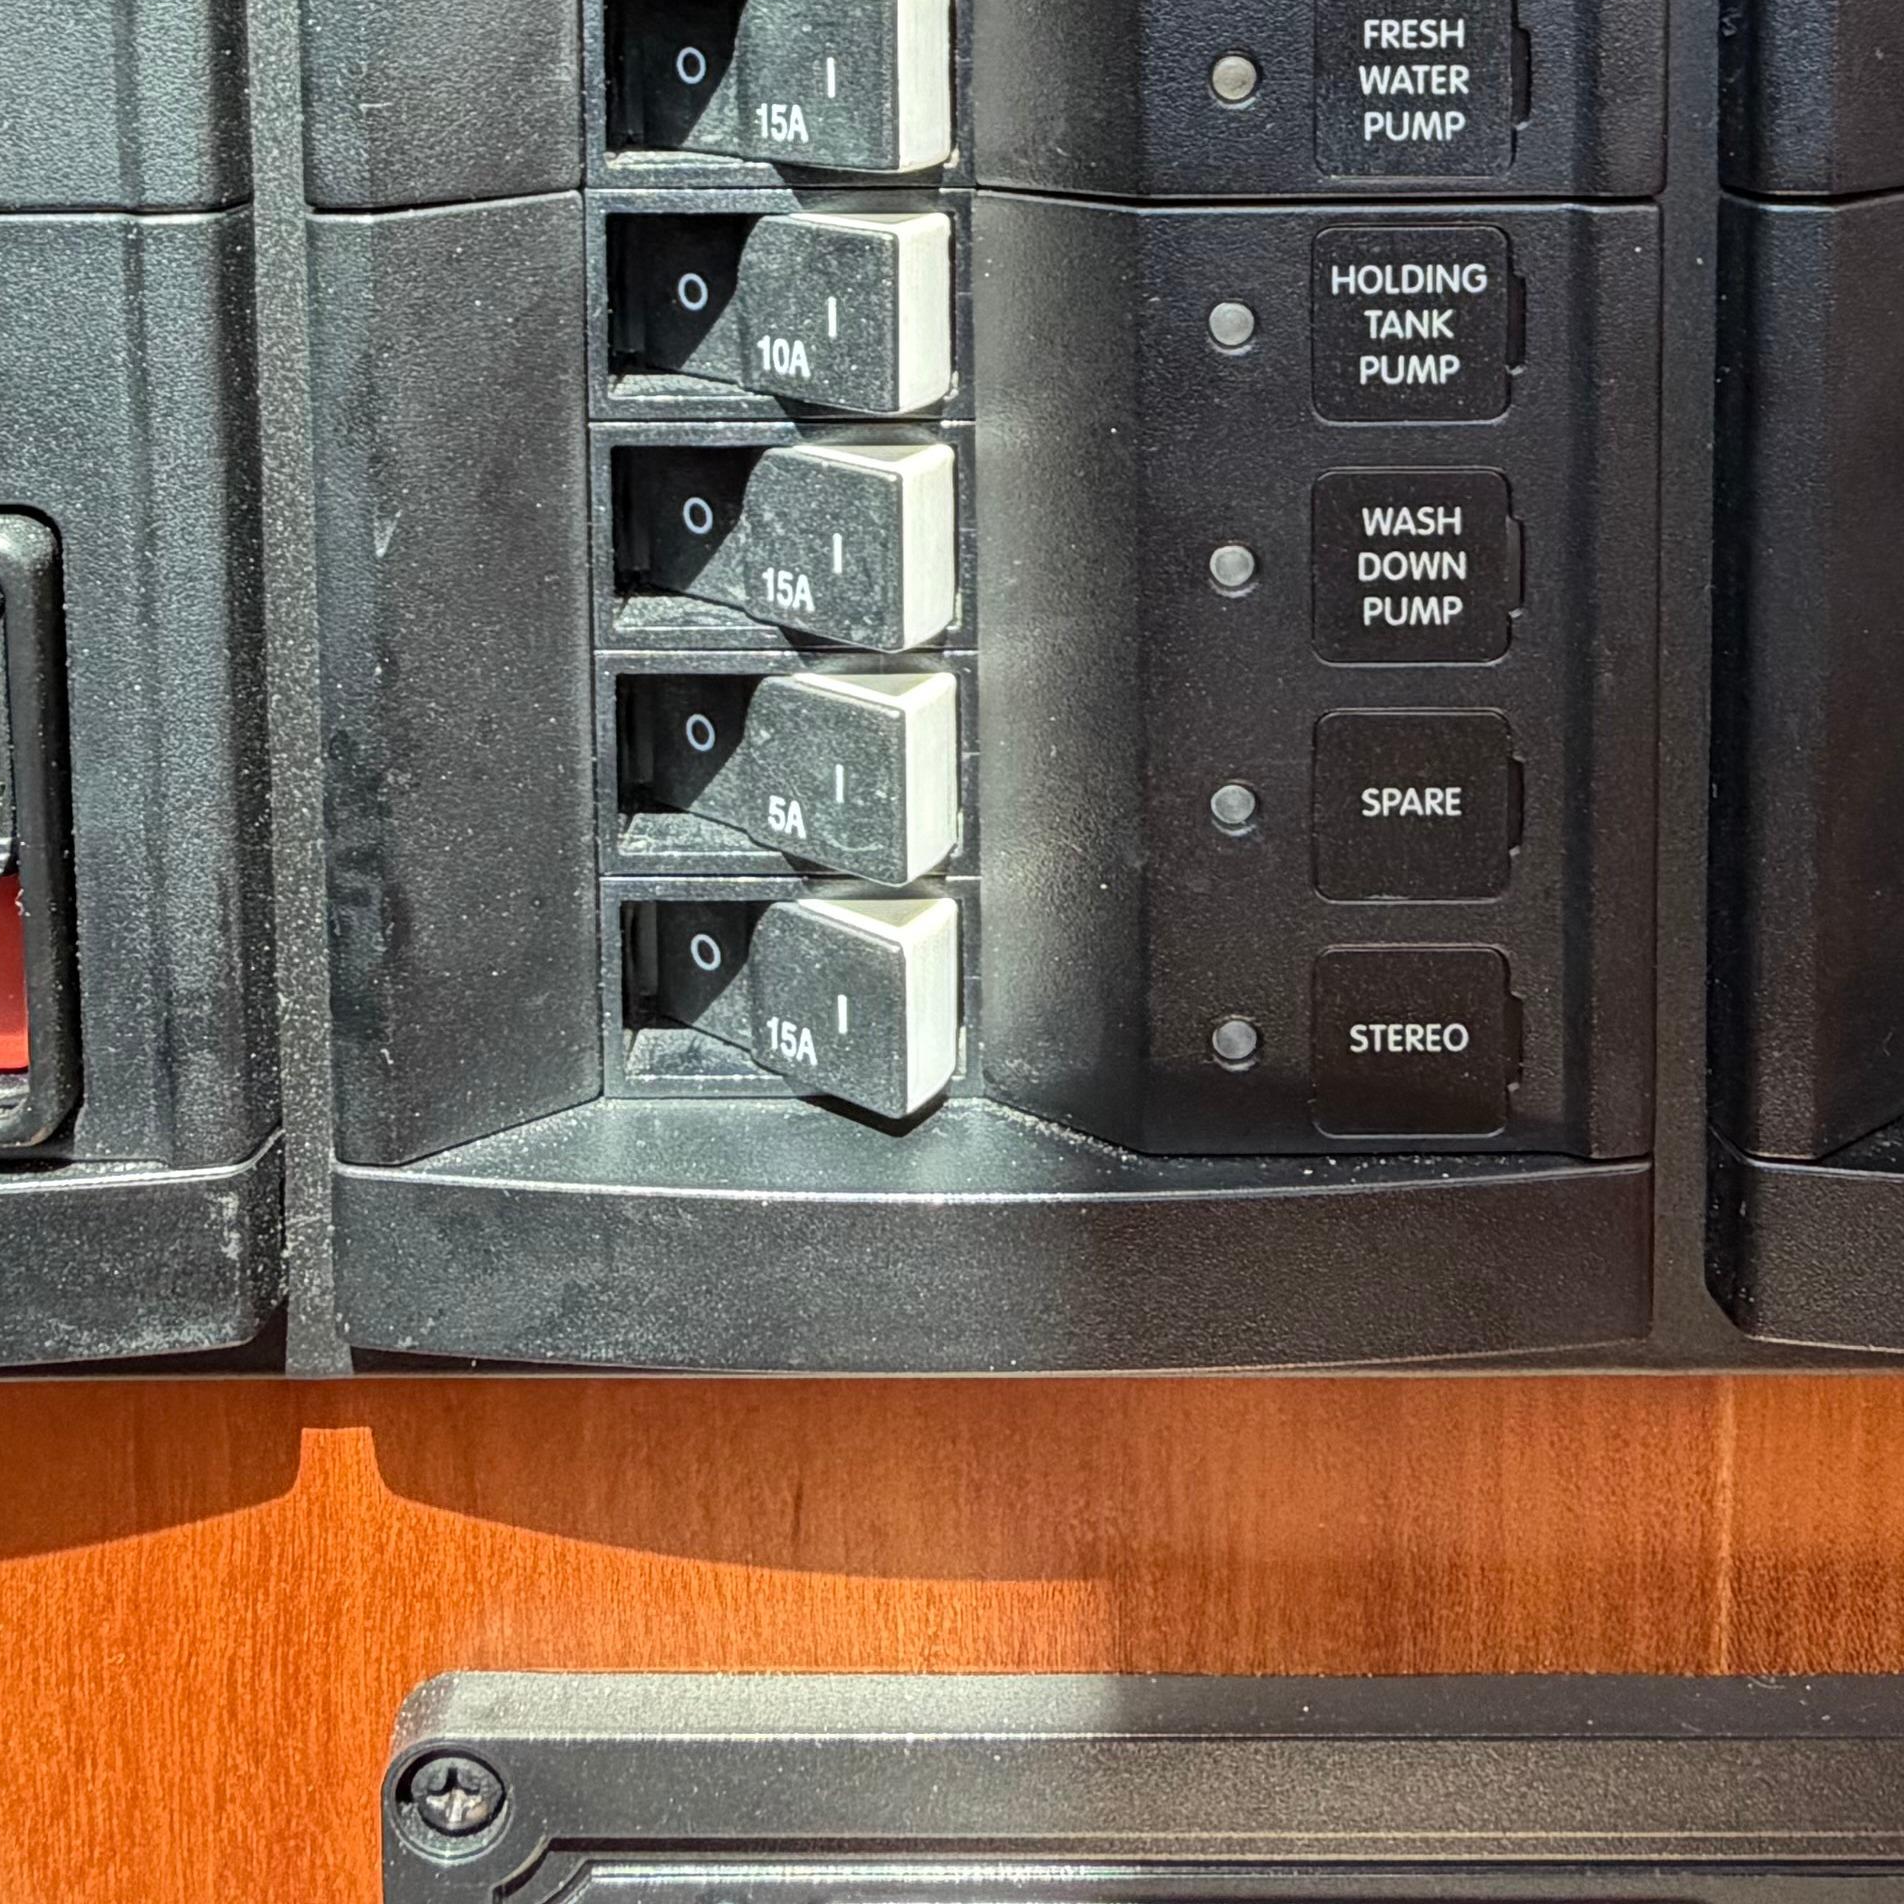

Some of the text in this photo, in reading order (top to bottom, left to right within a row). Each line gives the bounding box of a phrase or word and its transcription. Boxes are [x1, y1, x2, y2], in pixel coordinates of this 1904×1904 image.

[1363, 18, 1465, 49] FRESH
[1358, 64, 1470, 96] WATER
[755, 102, 809, 144] 15A
[1364, 110, 1466, 142] PUMP
[1331, 263, 1488, 295] HOLDING
[1363, 308, 1454, 340] TANK
[756, 334, 812, 379] 10A
[1359, 354, 1461, 385] PUMP
[1362, 506, 1462, 537] WASH
[1358, 550, 1467, 582] DOWN
[761, 566, 816, 613] 15A
[1363, 595, 1463, 626] PUMP
[767, 794, 807, 840] 5A
[1361, 787, 1462, 817] SPARE
[766, 1016, 818, 1067] 15A
[1349, 1023, 1469, 1053] STEREO
